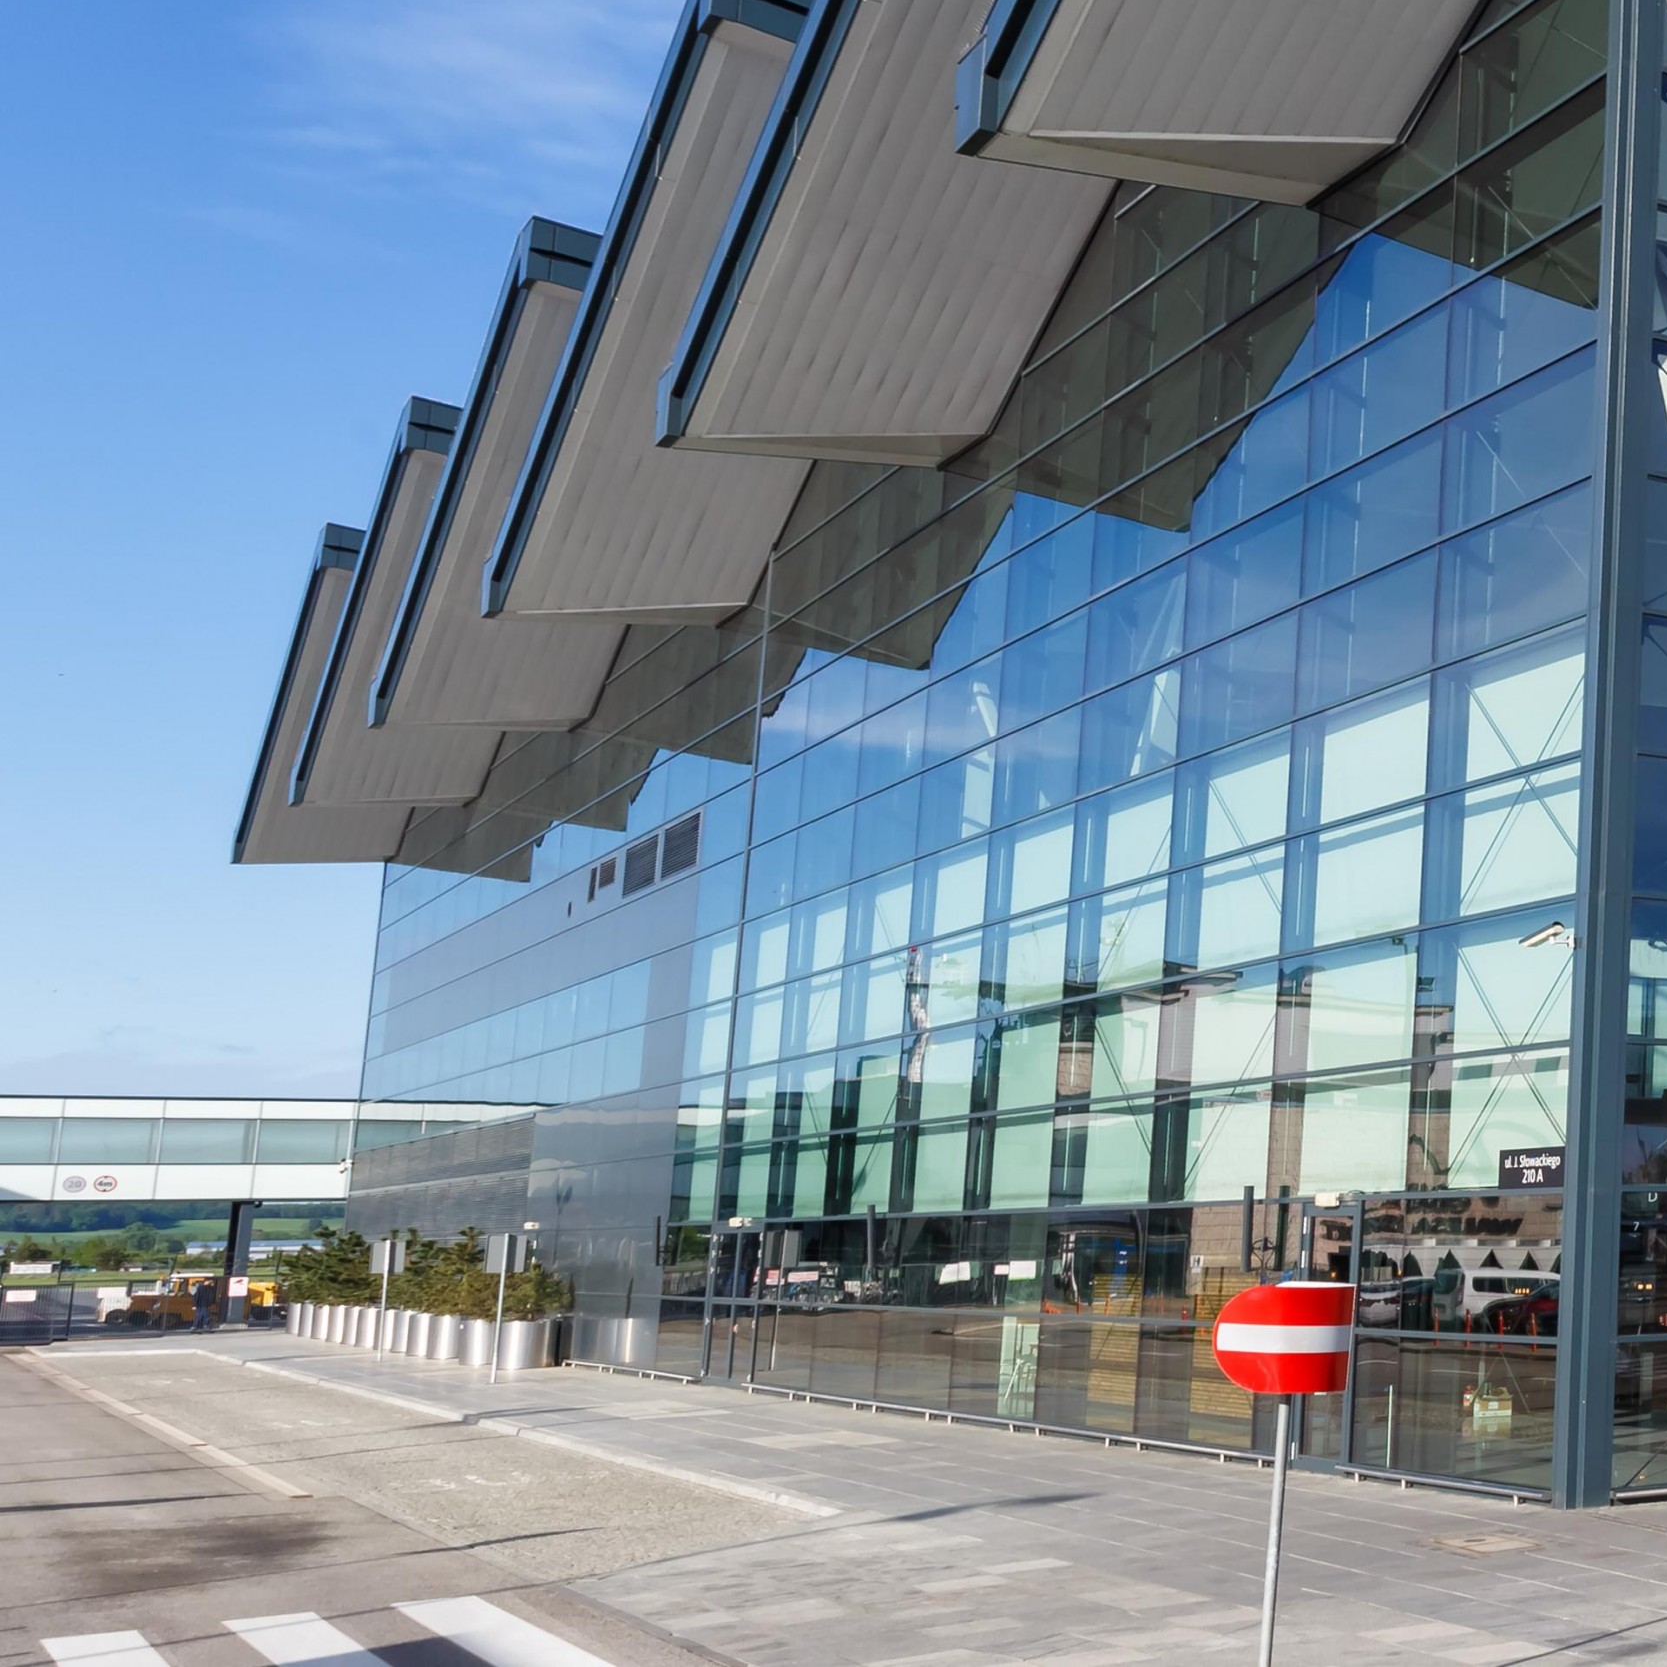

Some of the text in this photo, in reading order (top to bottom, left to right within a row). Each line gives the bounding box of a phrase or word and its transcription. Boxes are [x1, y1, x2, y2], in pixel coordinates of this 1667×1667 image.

[1522, 1168, 1544, 1184] 210 A
[68, 1180, 82, 1189] 20
